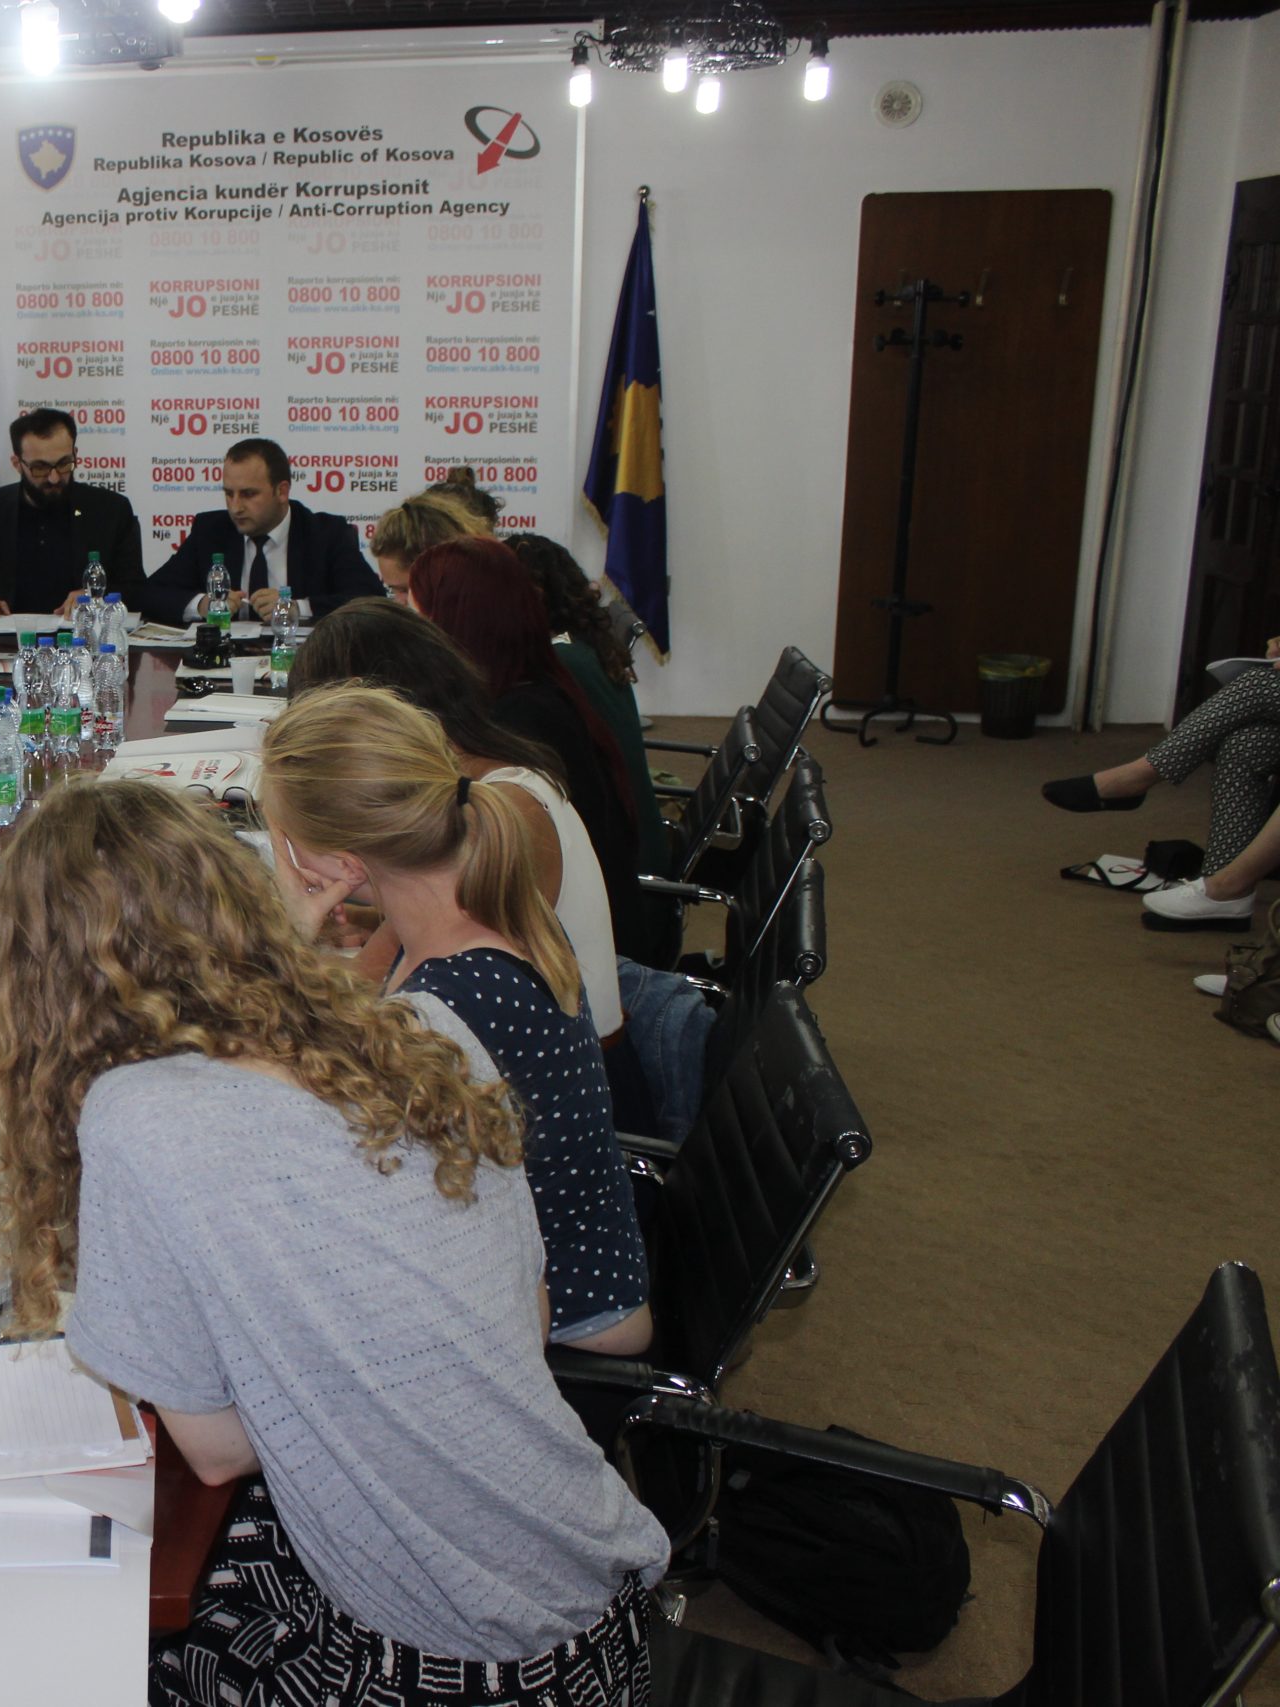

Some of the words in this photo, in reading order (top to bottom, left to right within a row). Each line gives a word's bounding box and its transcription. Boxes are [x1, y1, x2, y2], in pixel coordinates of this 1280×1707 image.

[162, 130, 265, 150] Republika
[273, 132, 285, 143] e
[293, 126, 383, 143] Kosovës
[94, 155, 183, 173] Republika
[190, 152, 256, 167] Kosova
[273, 148, 353, 167] Republic
[360, 148, 379, 162] of
[386, 147, 454, 162] Kosova
[117, 186, 207, 206] Agjencia
[216, 183, 288, 200] kundër
[296, 179, 430, 199] Korrupsionit
[42, 209, 119, 228] Agencija
[126, 208, 178, 225] protiv
[184, 205, 272, 223] Korupcije
[289, 202, 433, 218] Anti-Corruption
[440, 199, 510, 217] Agency
[150, 279, 260, 292] KORRUPSIONI
[427, 274, 541, 288] KORRUPSIONI
[17, 294, 59, 309] 0800
[65, 293, 86, 308] 10
[91, 292, 124, 307] 800
[288, 287, 332, 303] 0800
[339, 287, 361, 303] 10
[366, 287, 401, 303] 800
[447, 290, 486, 314] JO
[169, 295, 206, 318] JO
[18, 341, 124, 354] KORRUPSIONI
[288, 336, 399, 349] KORRUPSIONI
[151, 350, 194, 365] 0800
[200, 349, 222, 365] 10
[227, 349, 260, 364] 800
[426, 347, 471, 363] 0800
[478, 346, 500, 362] 10
[505, 346, 540, 362] 800
[36, 357, 72, 378] JO
[111, 355, 123, 363] ka
[77, 364, 124, 377] PESHË
[307, 352, 345, 375] JO
[387, 351, 399, 359] ka
[351, 360, 400, 373] PESHË
[151, 398, 260, 411] KORRUPSIONI
[288, 396, 324, 405] Raporto
[425, 396, 538, 409] KORRUPSIONI
[93, 410, 125, 425] 800
[288, 407, 332, 423] 0800
[338, 406, 360, 422] 10
[365, 406, 399, 422] 800
[151, 414, 169, 425] Një
[170, 413, 207, 435] JO
[247, 412, 259, 420] ka
[212, 421, 260, 434] PESHË
[444, 411, 483, 434] JO
[525, 411, 538, 419] ka
[489, 419, 538, 433] PESHË
[152, 456, 187, 465] Raporto
[289, 455, 398, 468] KORRUPSIONI
[424, 457, 461, 466] Raporto
[113, 471, 125, 479] ka
[153, 467, 195, 483] 0800
[202, 466, 223, 482] 10
[307, 470, 345, 493] JO
[385, 470, 398, 478] ka
[475, 467, 497, 483] 10
[503, 467, 537, 483] 800
[350, 478, 398, 492] PESHË
[153, 531, 171, 541] Një
